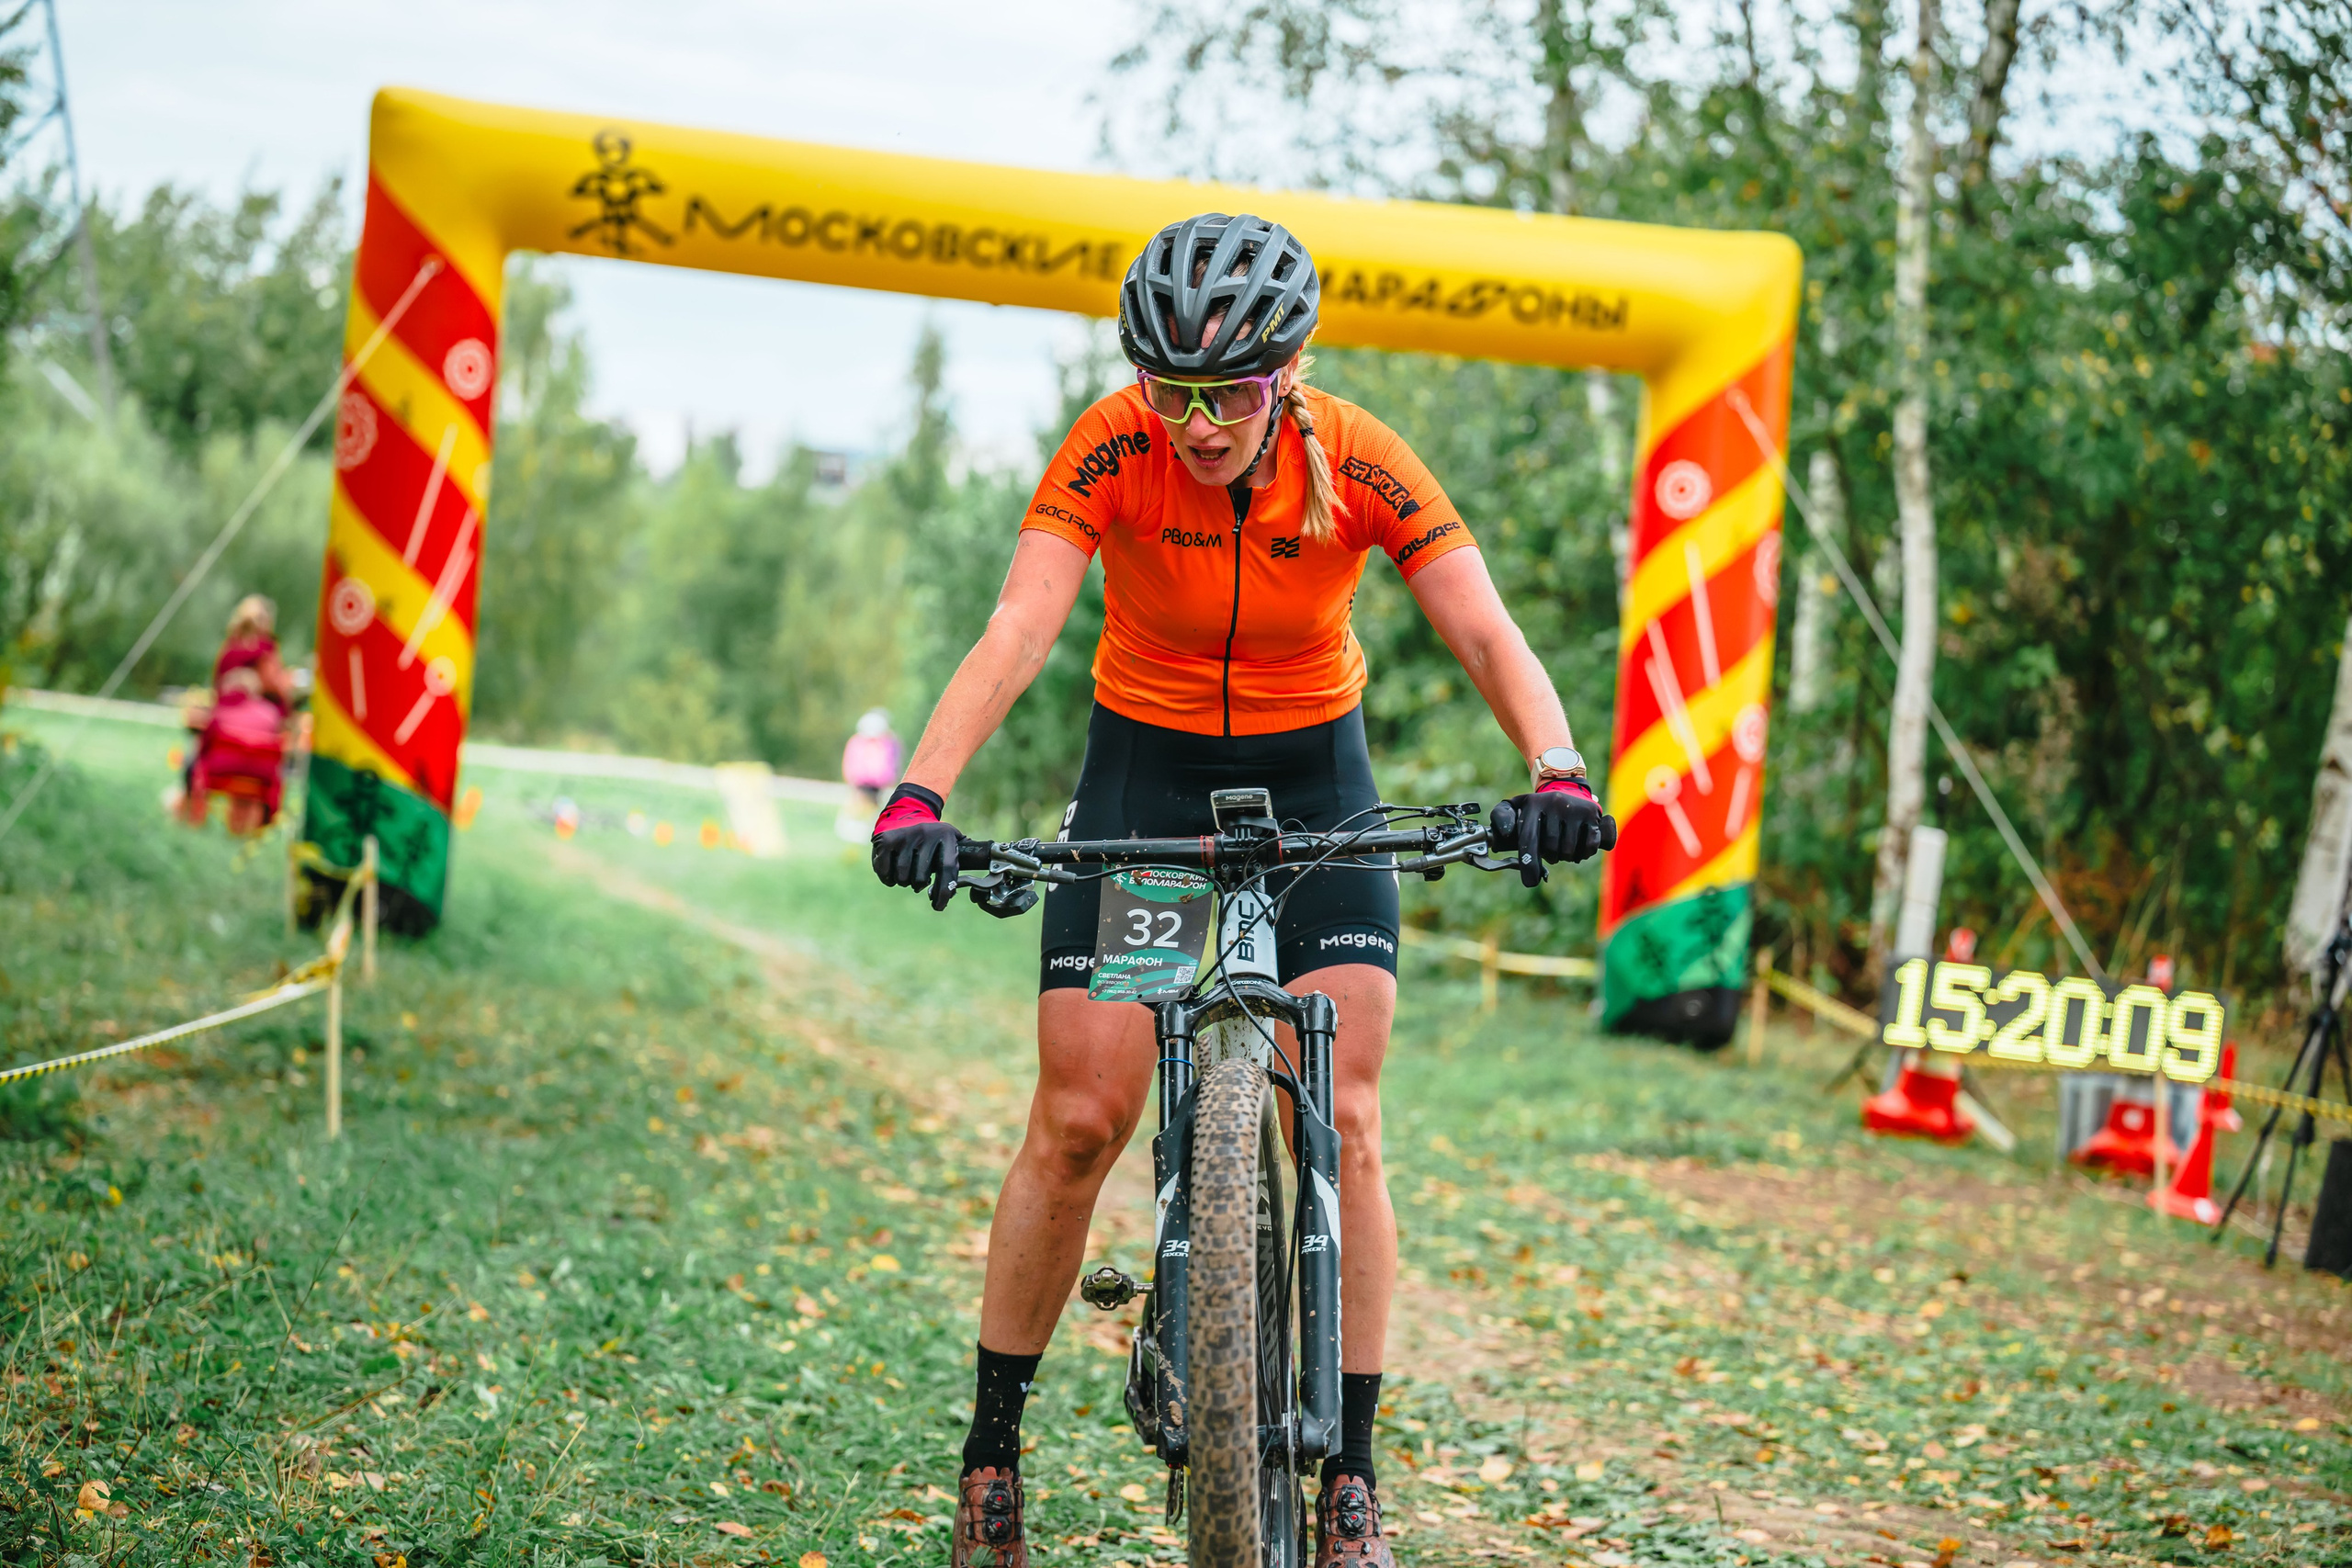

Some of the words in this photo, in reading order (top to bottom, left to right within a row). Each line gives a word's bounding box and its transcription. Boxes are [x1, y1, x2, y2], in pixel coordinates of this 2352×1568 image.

[683, 195, 1127, 282] МОСКОВСКИЕ
[1320, 268, 1631, 332] АРАФОНЫ
[1261, 301, 1285, 344] PMT
[1068, 431, 1151, 499] Magene
[1161, 528, 1222, 547] PBO&M
[1124, 908, 1182, 948] 32
[1237, 900, 1255, 963] BMC
[1320, 933, 1394, 953] Magene
[1049, 955, 1095, 971] Mage
[1102, 953, 1163, 966] МАРАФОН
[1883, 957, 2224, 1083] 15:20:09
[1163, 1239, 1191, 1253] 34
[1302, 1235, 1329, 1249] 34
